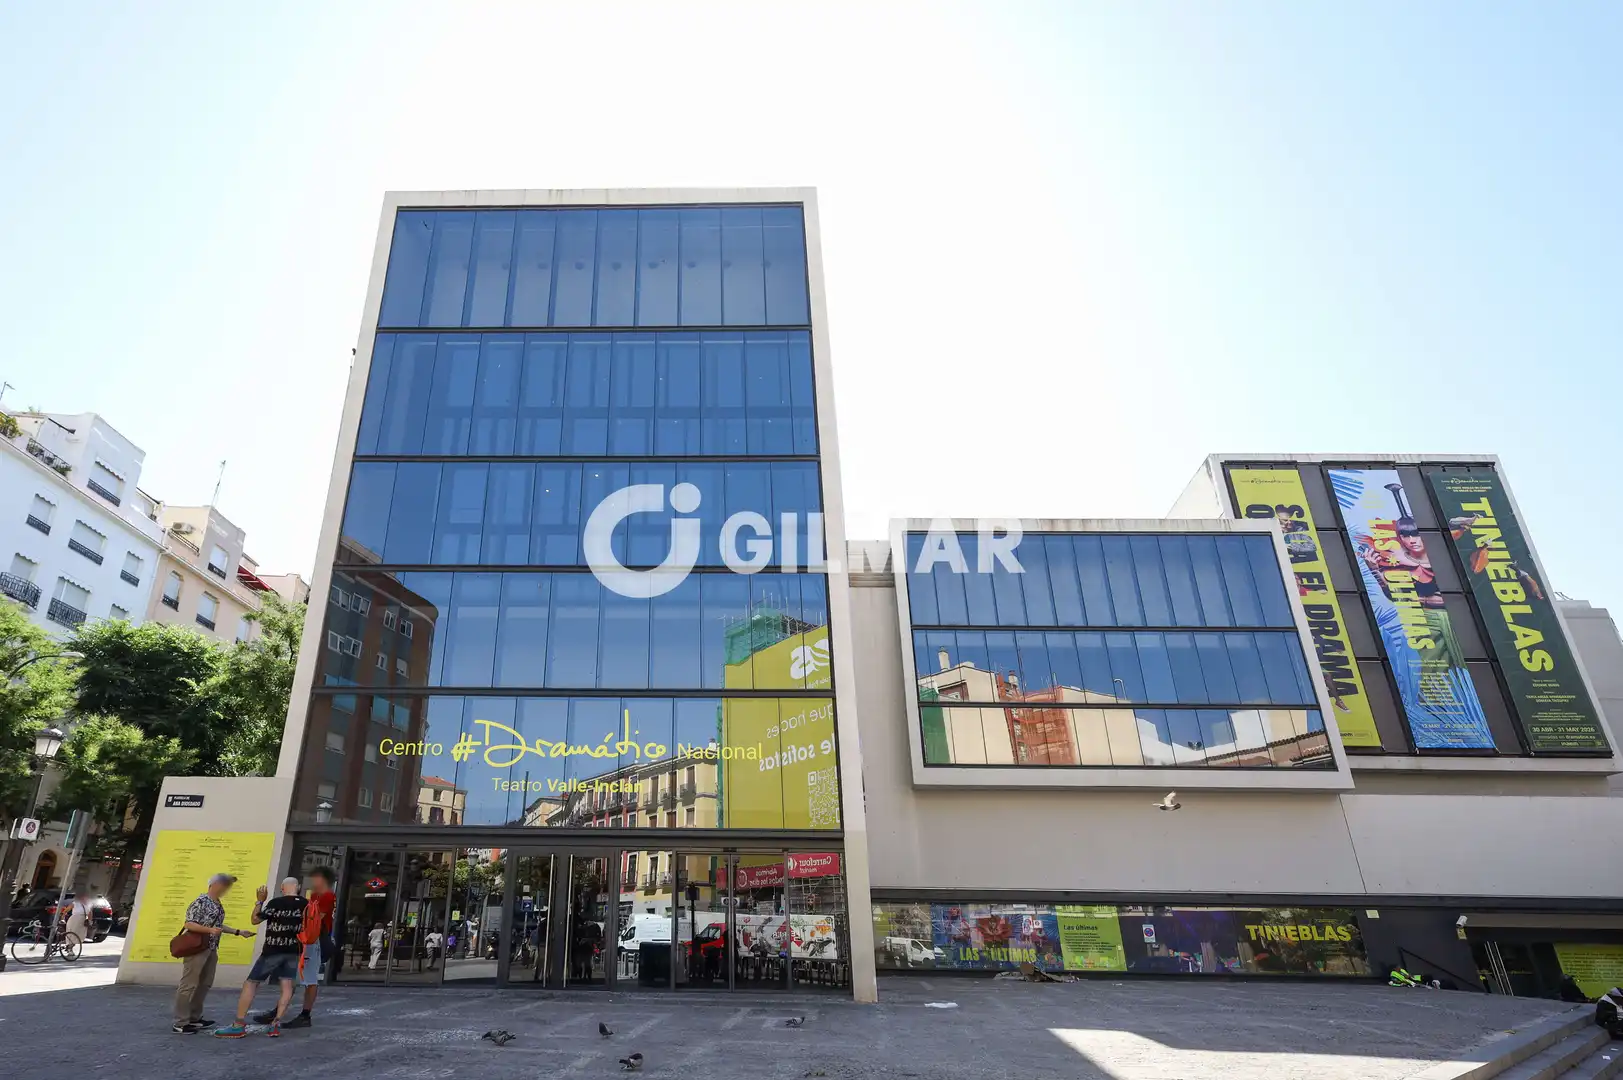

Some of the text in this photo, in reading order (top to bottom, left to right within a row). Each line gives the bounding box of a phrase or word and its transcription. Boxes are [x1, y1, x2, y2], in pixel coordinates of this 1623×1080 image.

[1461, 497, 1554, 673] TINIEBLAS
[1303, 604, 1359, 698] DRAMA
[379, 738, 443, 756] Centro
[677, 743, 763, 760] Nacional
[492, 778, 644, 793] Teatro Valle-Inclán
[1245, 924, 1351, 942] TINIEBLAS
[960, 947, 979, 961] LAS
